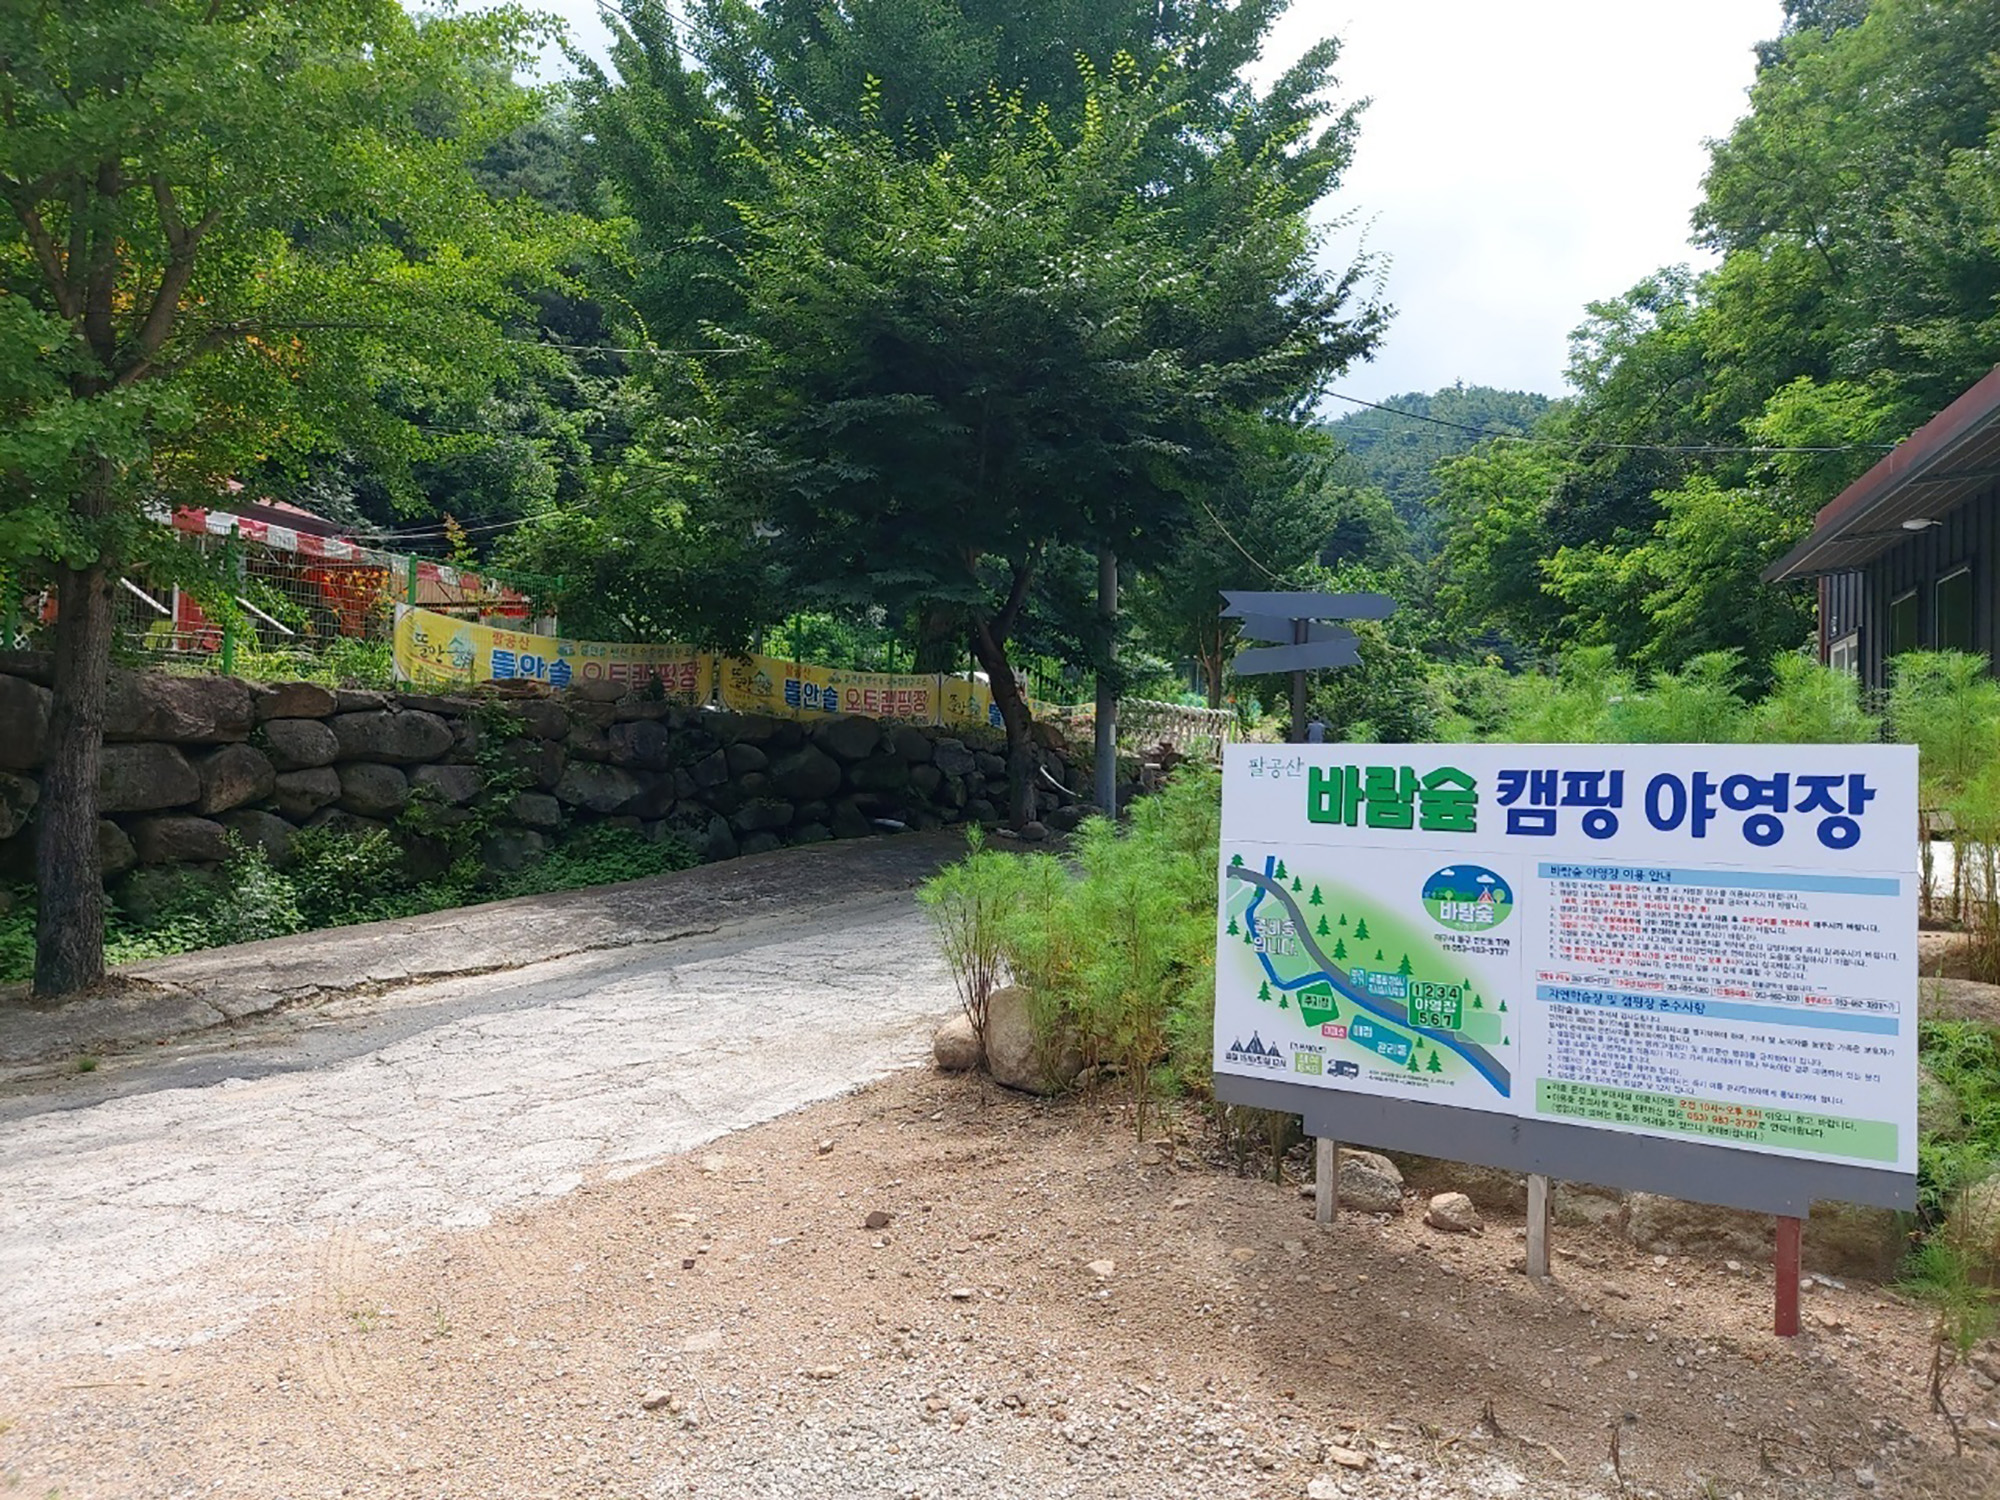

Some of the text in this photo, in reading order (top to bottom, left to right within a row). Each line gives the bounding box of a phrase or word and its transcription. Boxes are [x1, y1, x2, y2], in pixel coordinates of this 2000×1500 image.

[844, 687, 930, 717] 오토캠핑장
[1249, 756, 1877, 850] 팔공산 바람숲 캠핑 야영장
[1550, 864, 1671, 883] 바람숲 야영장 이용 안내
[1440, 901, 1494, 925] 바람숲
[1415, 998, 1457, 1013] 야영장
[1548, 987, 1602, 1005] 자연학습장
[1606, 993, 1616, 1007] 및
[1658, 998, 1706, 1016] 준수사항
[1600, 1088, 1632, 1101] 부대시설
[1679, 1099, 1696, 1110] 오전
[1817, 1117, 1857, 1132] 바랍니다.
